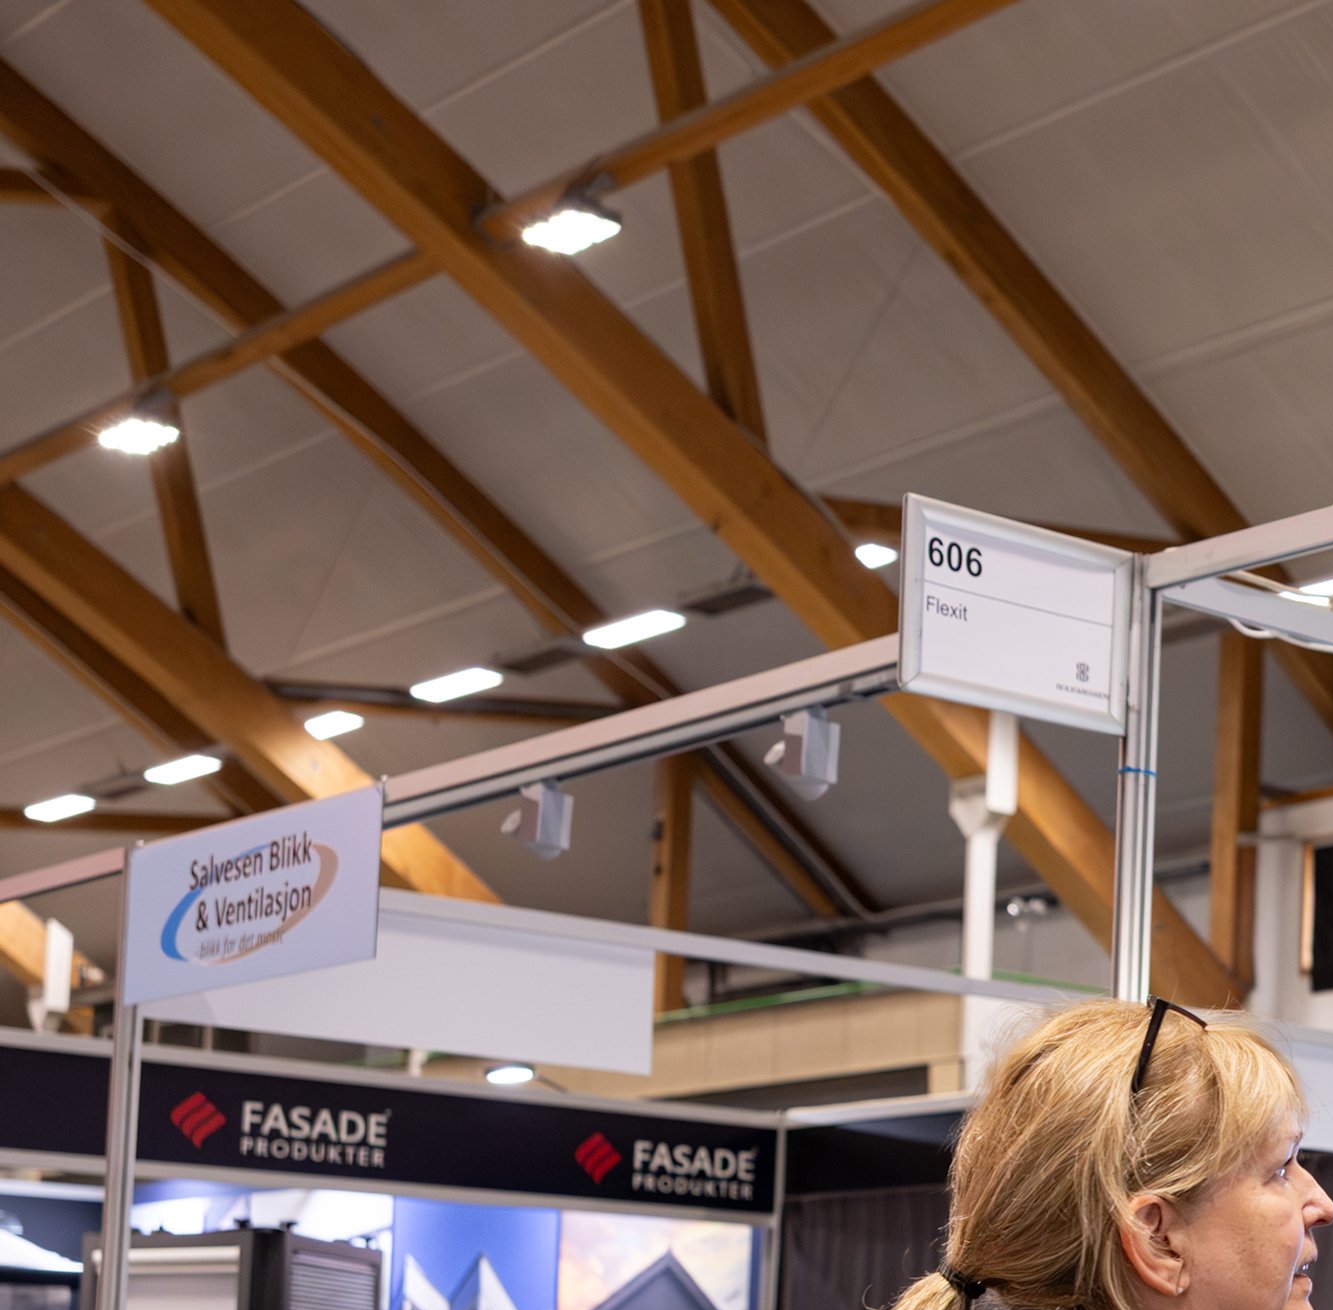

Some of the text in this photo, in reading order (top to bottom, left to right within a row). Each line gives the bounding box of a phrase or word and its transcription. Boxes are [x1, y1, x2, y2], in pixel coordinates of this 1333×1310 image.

[928, 537, 983, 577] 606
[926, 595, 968, 622] Flexit
[190, 831, 312, 891] Salvesen Blikk
[195, 882, 312, 932] & Ventilasjon
[240, 1101, 387, 1147] FASADE
[240, 1135, 385, 1168] PRODUKTER
[633, 1140, 756, 1182] FASADE
[632, 1172, 753, 1200] PRODUKTER
